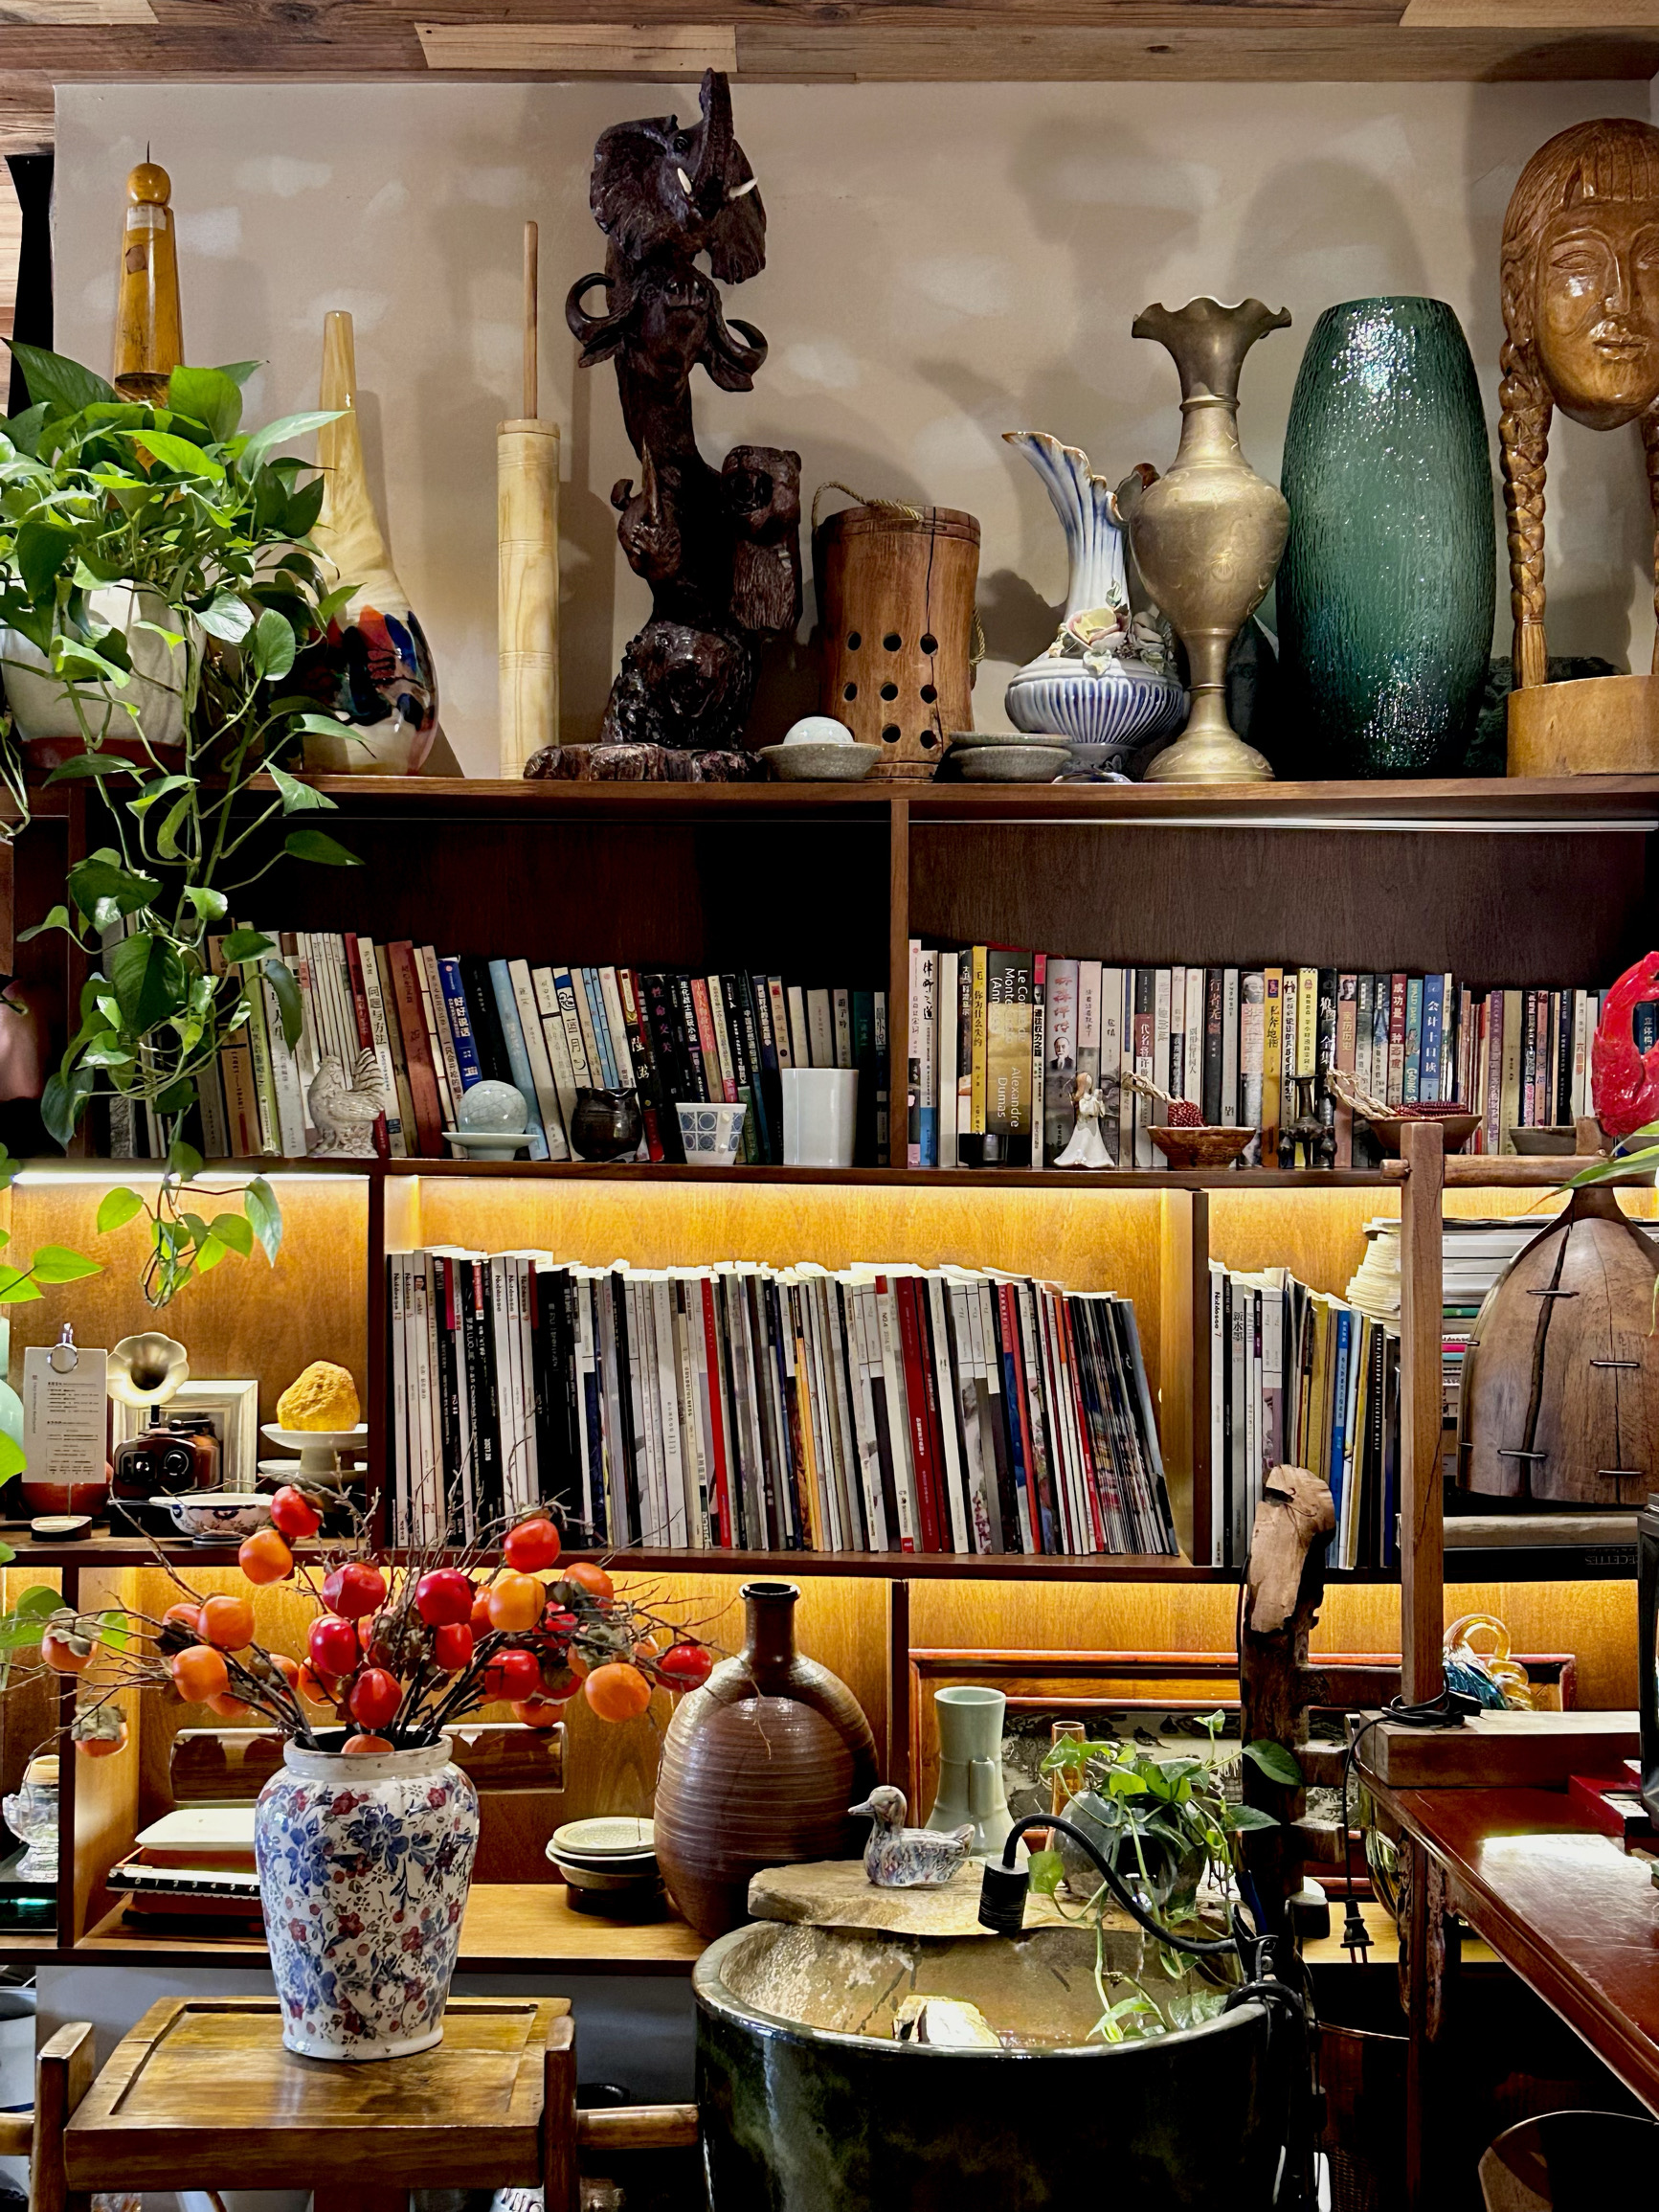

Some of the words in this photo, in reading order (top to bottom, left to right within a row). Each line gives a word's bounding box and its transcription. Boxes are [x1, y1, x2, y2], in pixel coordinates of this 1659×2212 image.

[1018, 969, 1028, 983] Le
[1390, 983, 1403, 1069] 成功是一种态度
[998, 1077, 1008, 1118] Dumas
[1011, 1067, 1022, 1128] Alexandre
